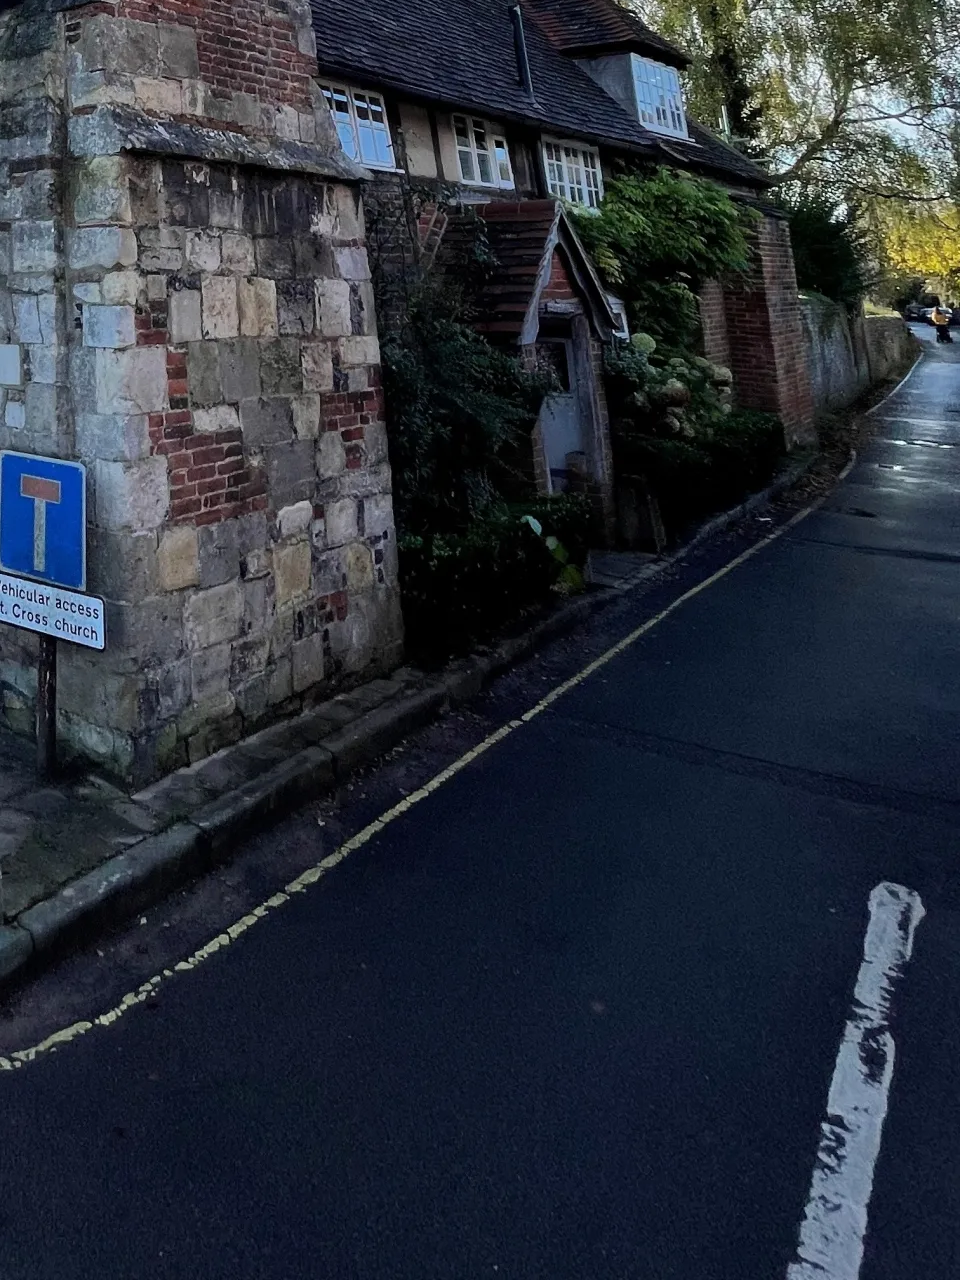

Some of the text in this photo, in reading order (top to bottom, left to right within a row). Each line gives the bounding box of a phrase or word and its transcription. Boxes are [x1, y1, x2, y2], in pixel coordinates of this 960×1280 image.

[12, 604, 48, 626] Cross
[54, 617, 98, 641] church
[55, 597, 99, 619] access
